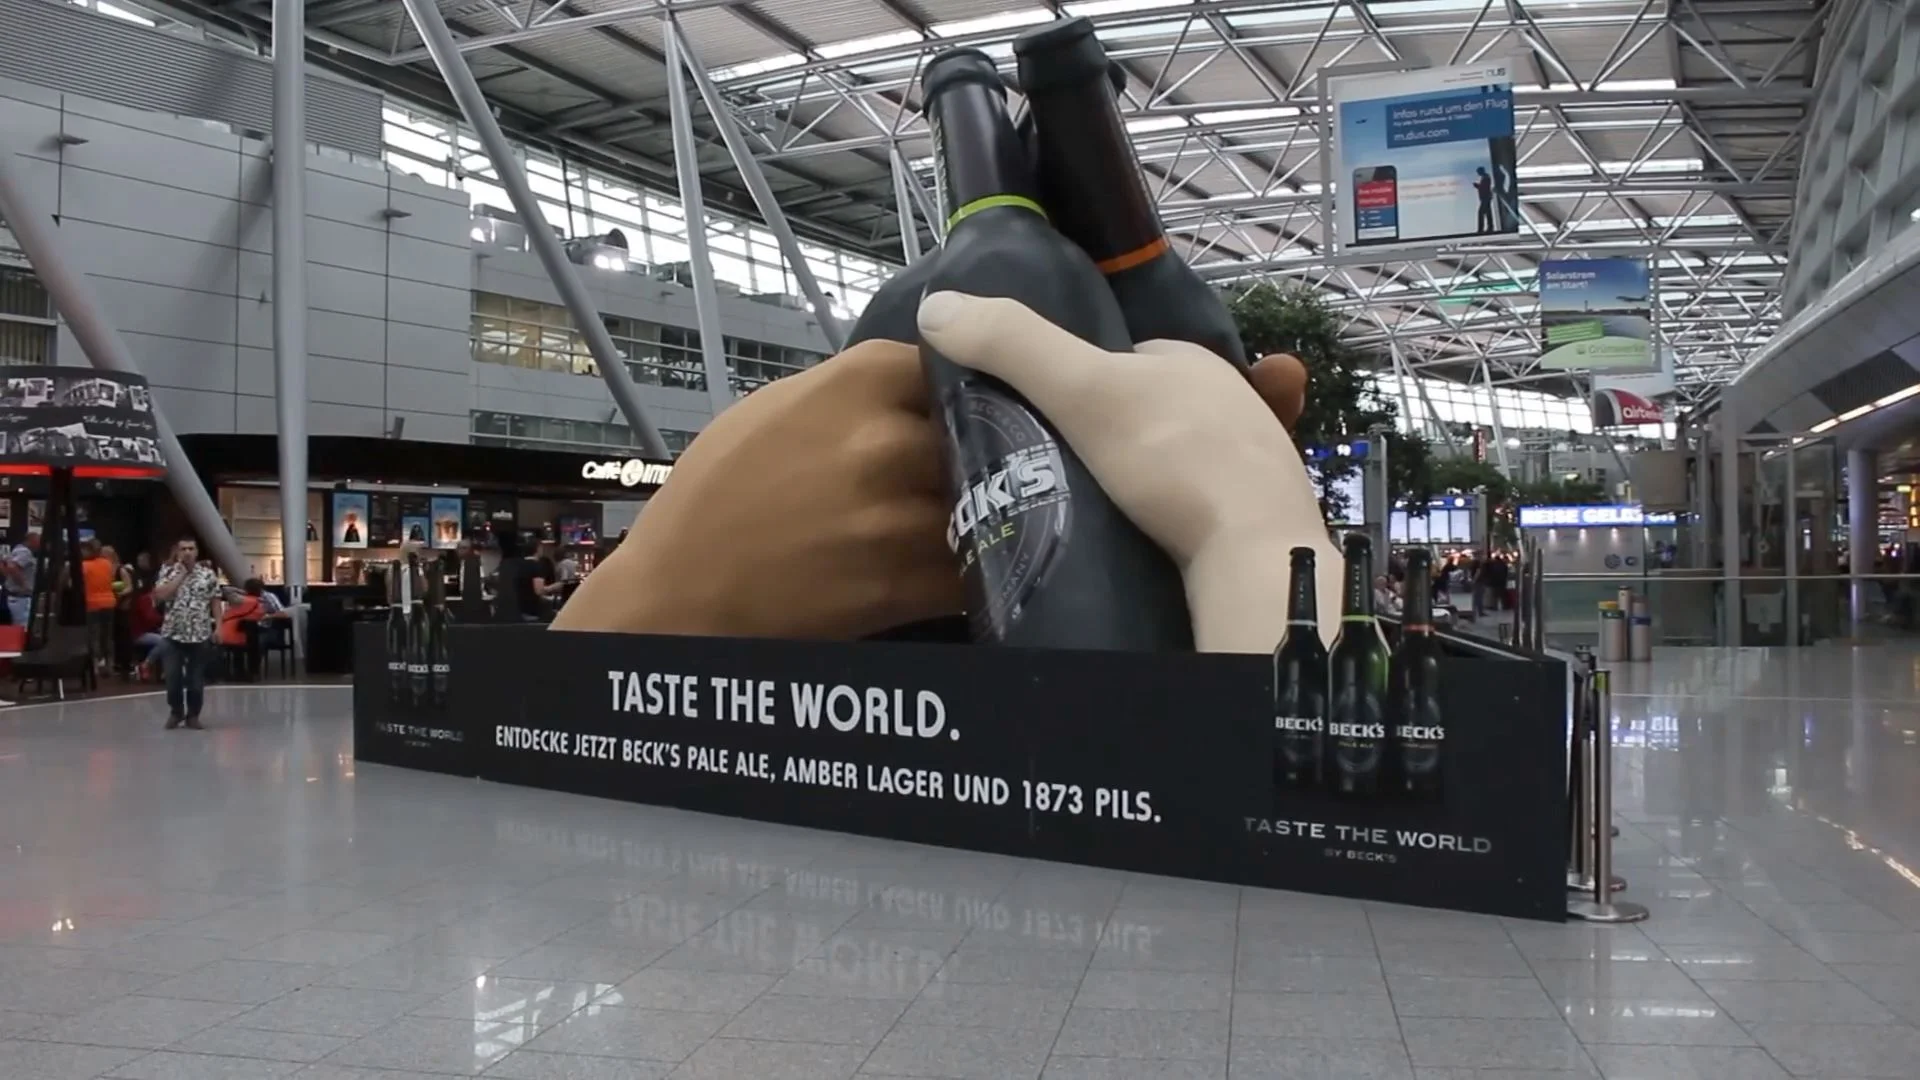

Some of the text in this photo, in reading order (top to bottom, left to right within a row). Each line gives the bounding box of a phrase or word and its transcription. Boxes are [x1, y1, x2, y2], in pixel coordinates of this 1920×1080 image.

[1393, 98, 1509, 120] Infos rund um den Flug
[1394, 128, 1449, 141] m.dus.com
[1545, 271, 1596, 280] Solarstrom
[977, 522, 1016, 554] ALE
[608, 670, 960, 741] TASTE THE WORLD.
[1329, 722, 1385, 738] BECK'S
[495, 725, 1162, 823] ENTDECKE JETZT BECK'S PALE ALE, AMBER LAGER UND 1873 PILS.
[1243, 816, 1492, 853] TASTE THE WORLD
[1324, 848, 1397, 863] BY BECK'S
